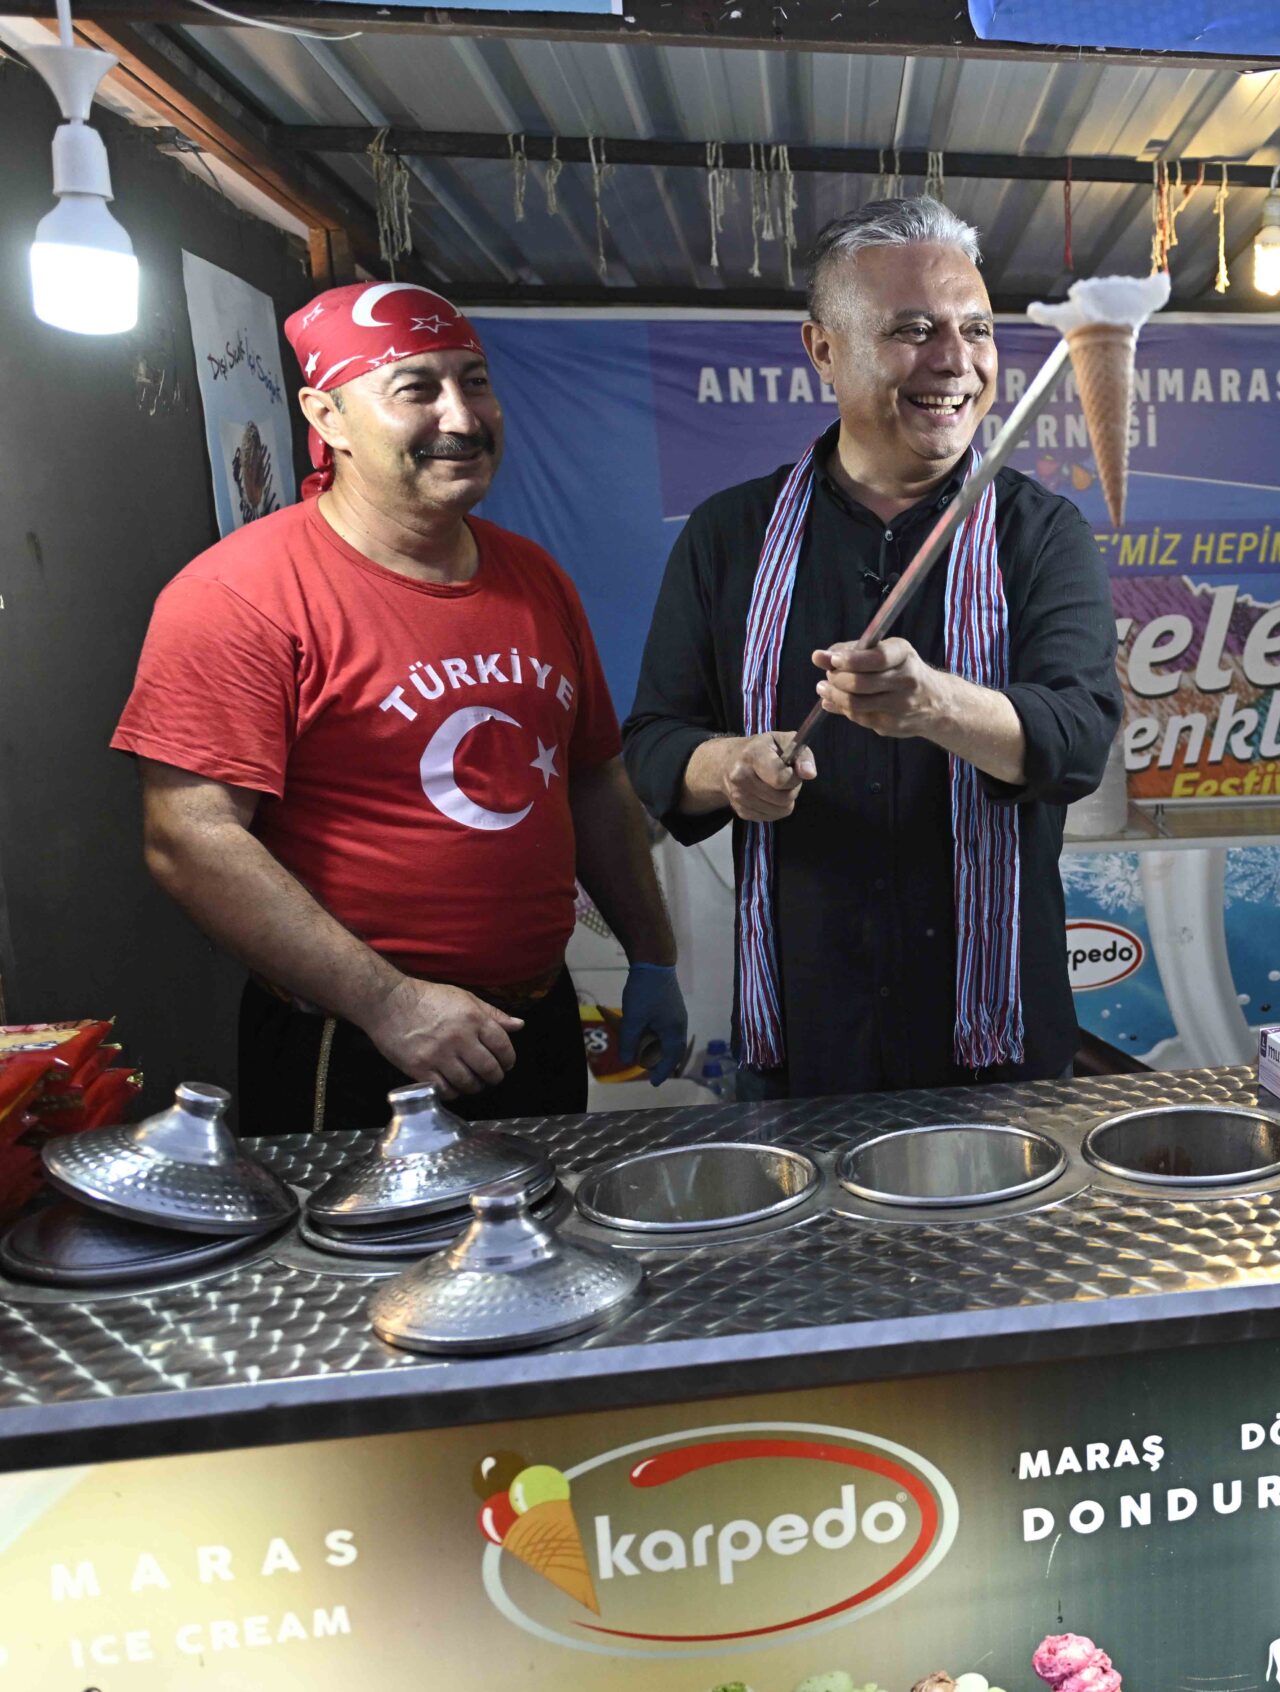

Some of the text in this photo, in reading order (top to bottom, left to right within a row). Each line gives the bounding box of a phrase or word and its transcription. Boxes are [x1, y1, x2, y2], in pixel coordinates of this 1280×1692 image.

[379, 648, 574, 722] TÜRKİYE
[1018, 1434, 1166, 1480] MARAŞ
[50, 1529, 358, 1601] MARAS
[595, 1484, 907, 1585] karpedo
[69, 1604, 351, 1668] ICE CREAM
